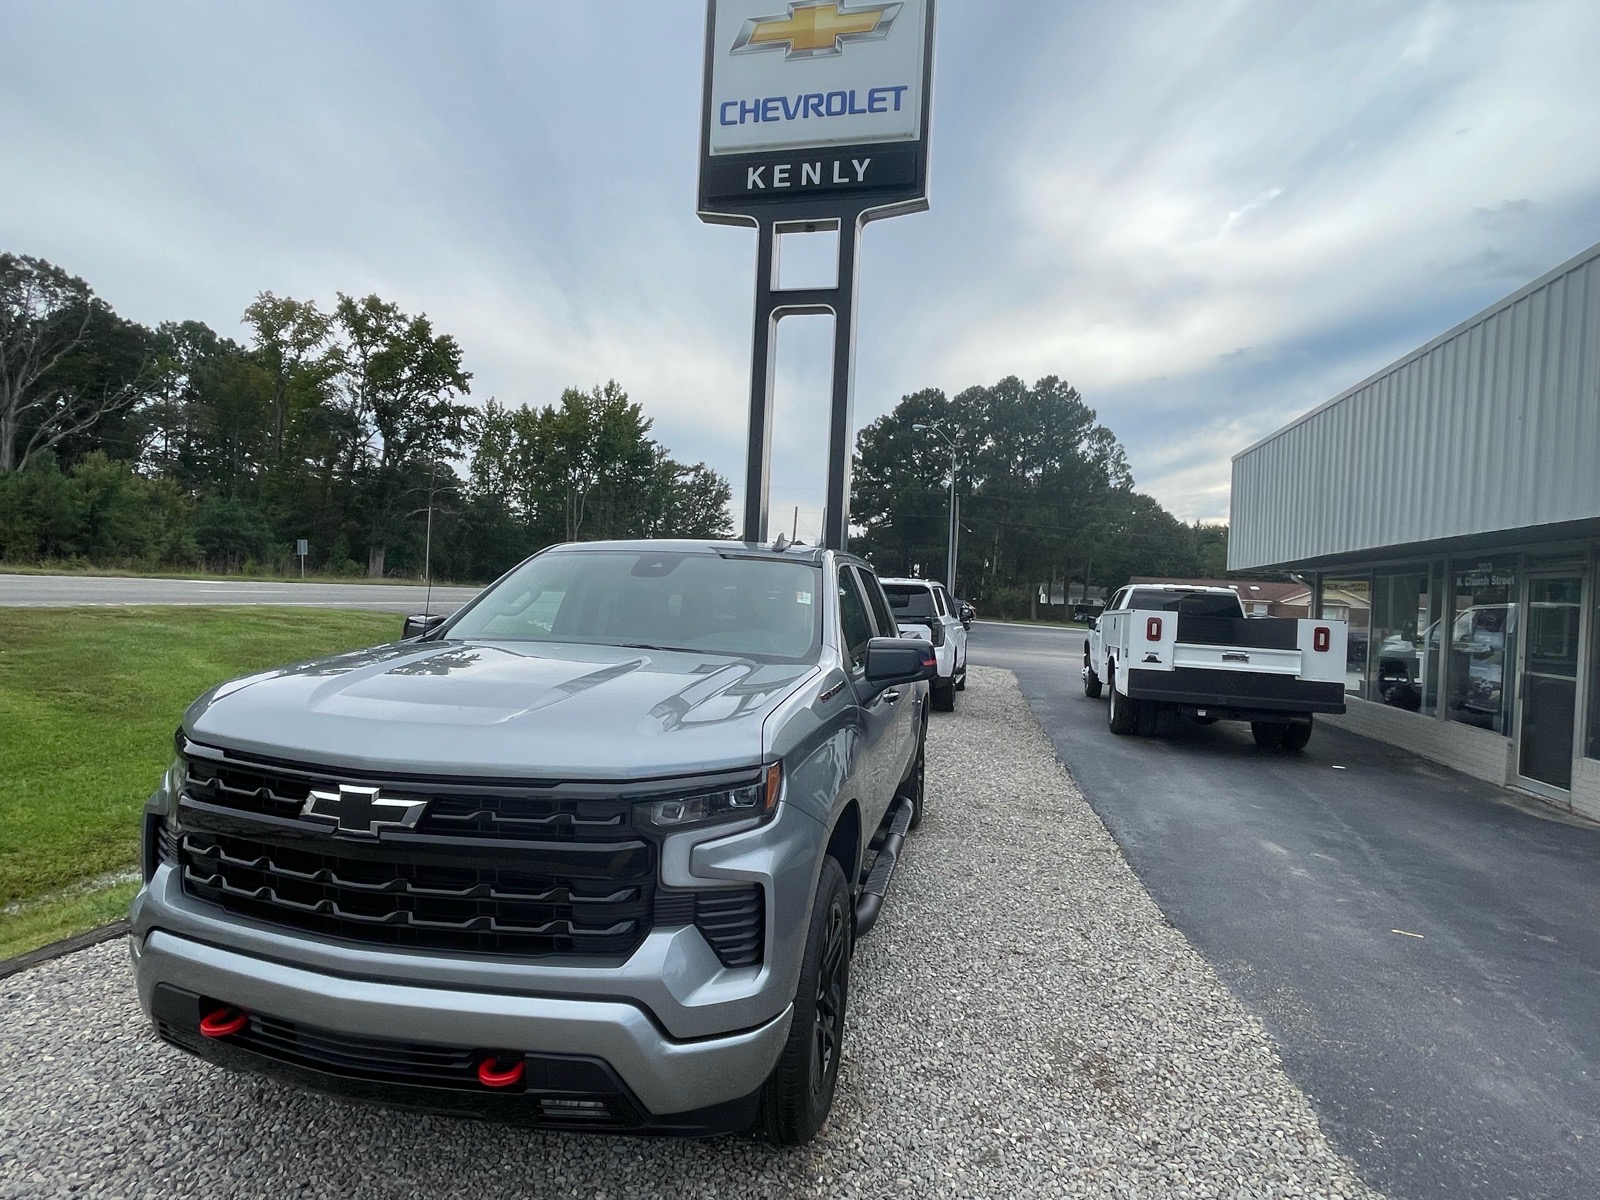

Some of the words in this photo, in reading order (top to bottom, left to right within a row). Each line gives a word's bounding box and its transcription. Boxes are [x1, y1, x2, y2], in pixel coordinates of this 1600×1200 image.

[720, 85, 908, 126] CHEVROLET
[747, 158, 871, 189] KENLY
[1464, 576, 1490, 587] Church
[1491, 575, 1515, 586] Street
